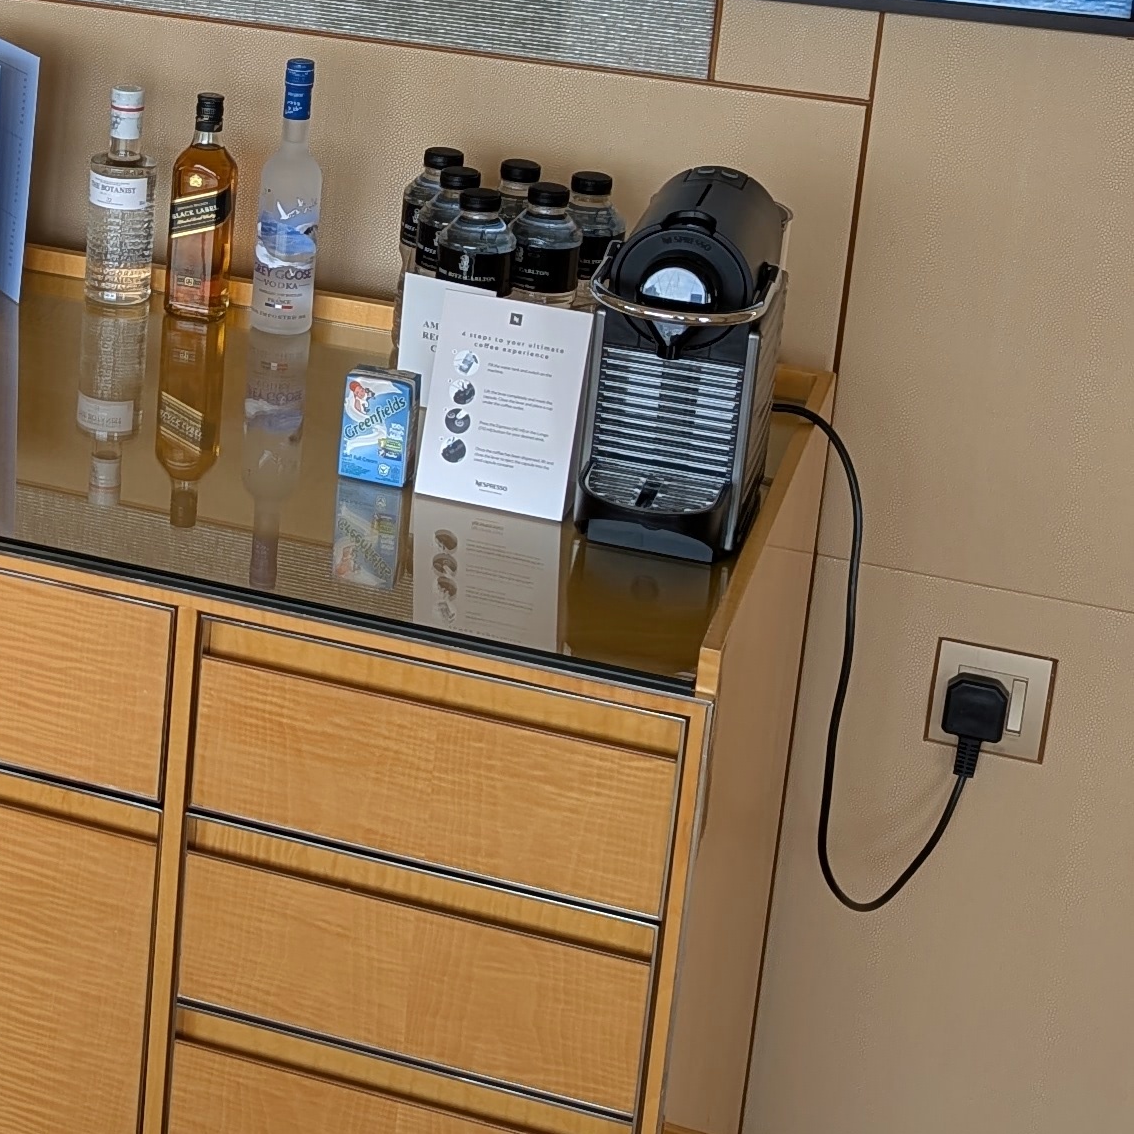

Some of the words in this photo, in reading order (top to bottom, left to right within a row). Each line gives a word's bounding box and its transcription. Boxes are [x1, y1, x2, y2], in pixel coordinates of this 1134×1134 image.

[263, 278, 299, 290] VODKA
[469, 332, 492, 341] steps
[495, 336, 504, 344] to
[507, 339, 526, 348] your
[528, 342, 565, 355] ultimate
[473, 341, 500, 352] coffee
[502, 346, 550, 360] experience
[344, 396, 406, 440] Greenfields
[475, 479, 508, 492] NESPRESSO
